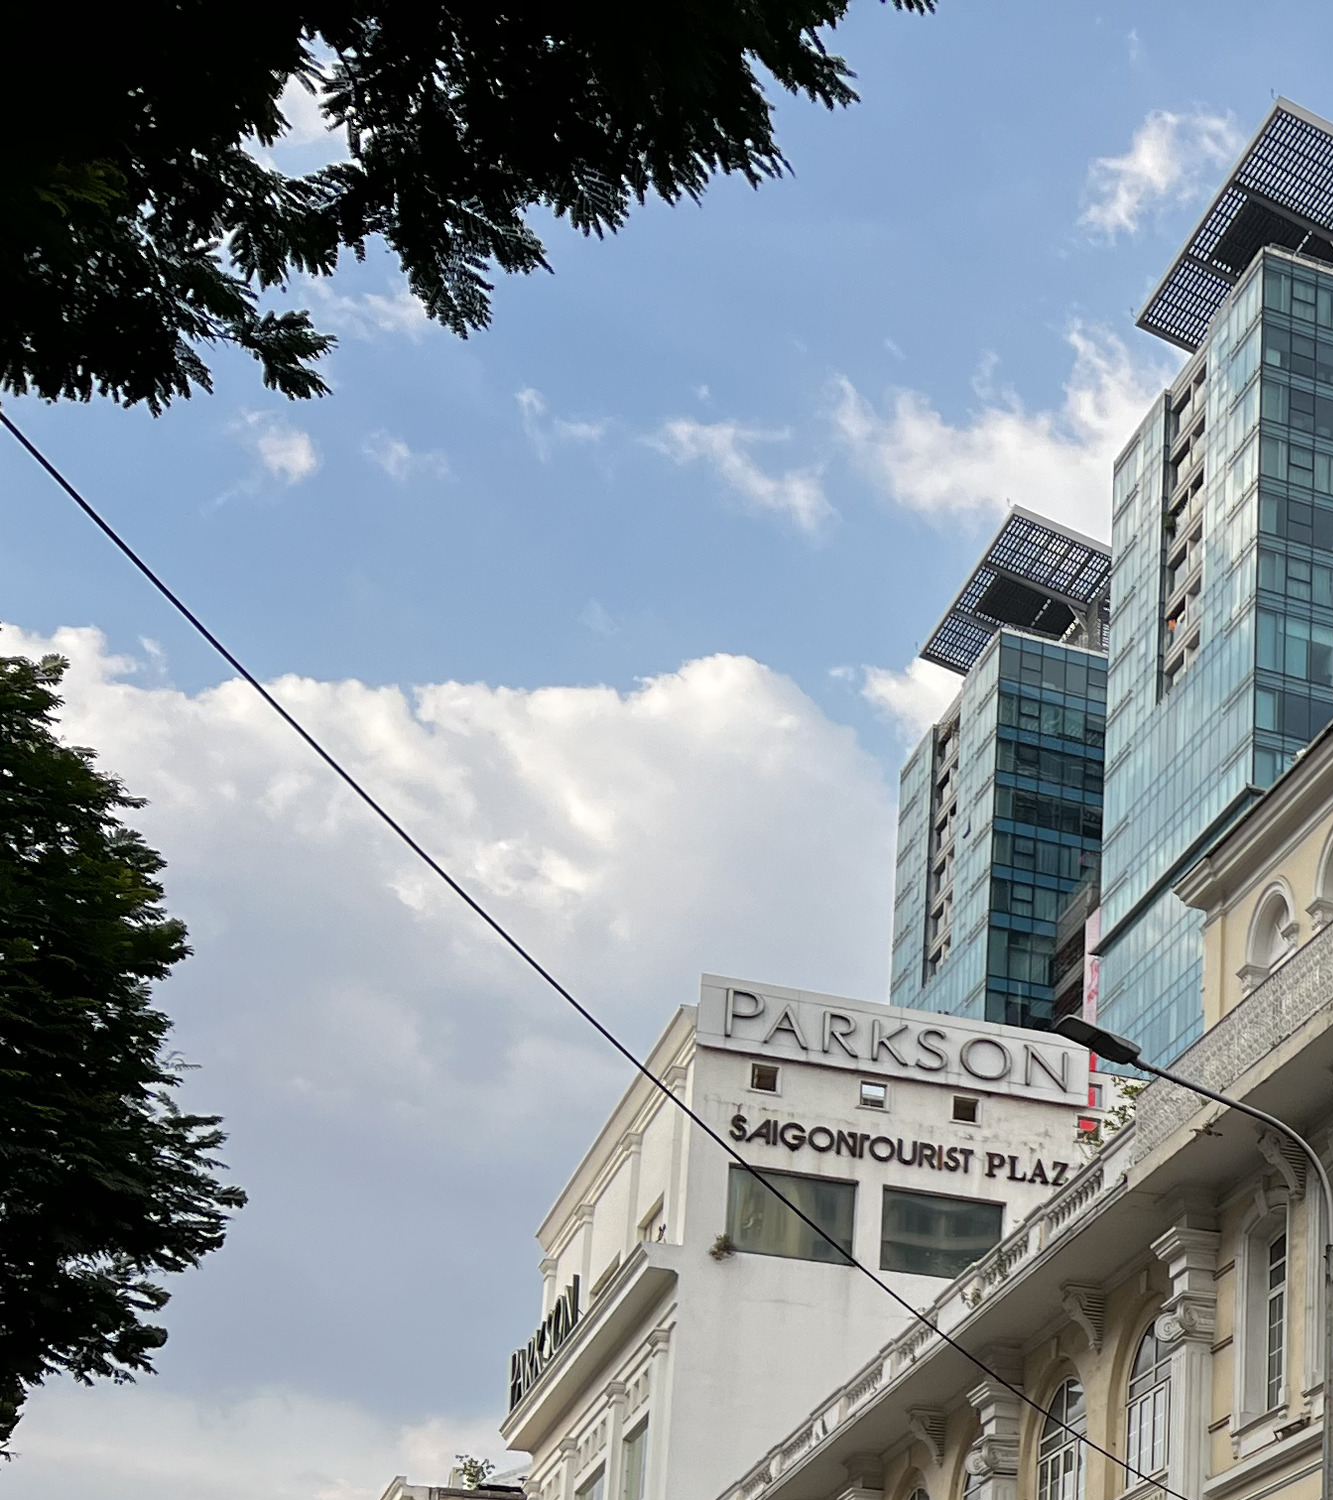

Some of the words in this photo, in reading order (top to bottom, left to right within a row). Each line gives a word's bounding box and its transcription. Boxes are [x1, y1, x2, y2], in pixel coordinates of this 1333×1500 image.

[724, 987, 1070, 1094] PARKSON
[729, 1113, 974, 1174] SAIGONTOURIST
[985, 1151, 1076, 1187] PLAZ
[509, 1273, 580, 1414] PARKSON
